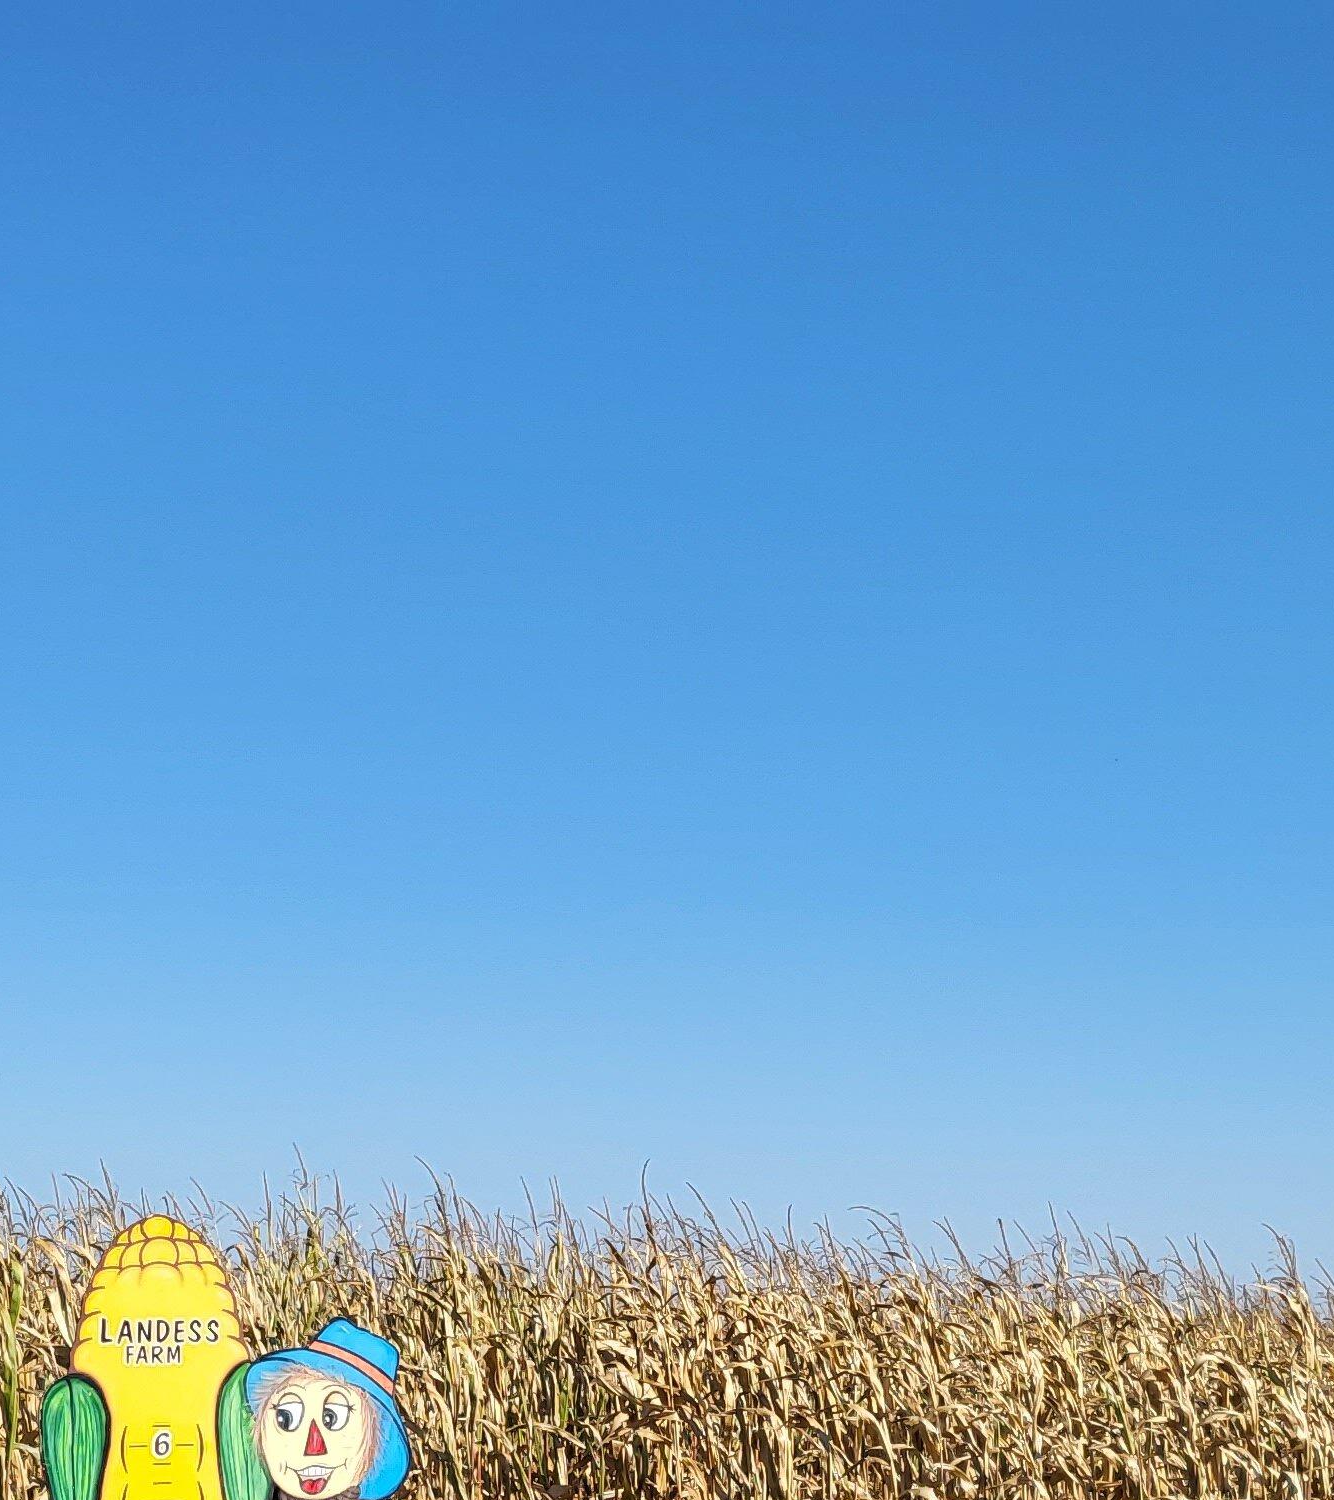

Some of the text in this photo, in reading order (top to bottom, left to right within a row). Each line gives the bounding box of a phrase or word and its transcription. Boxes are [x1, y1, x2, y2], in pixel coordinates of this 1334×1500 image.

[100, 1317, 220, 1344] LANDESS
[126, 1345, 181, 1364] FARM
[154, 1432, 170, 1456] 6
